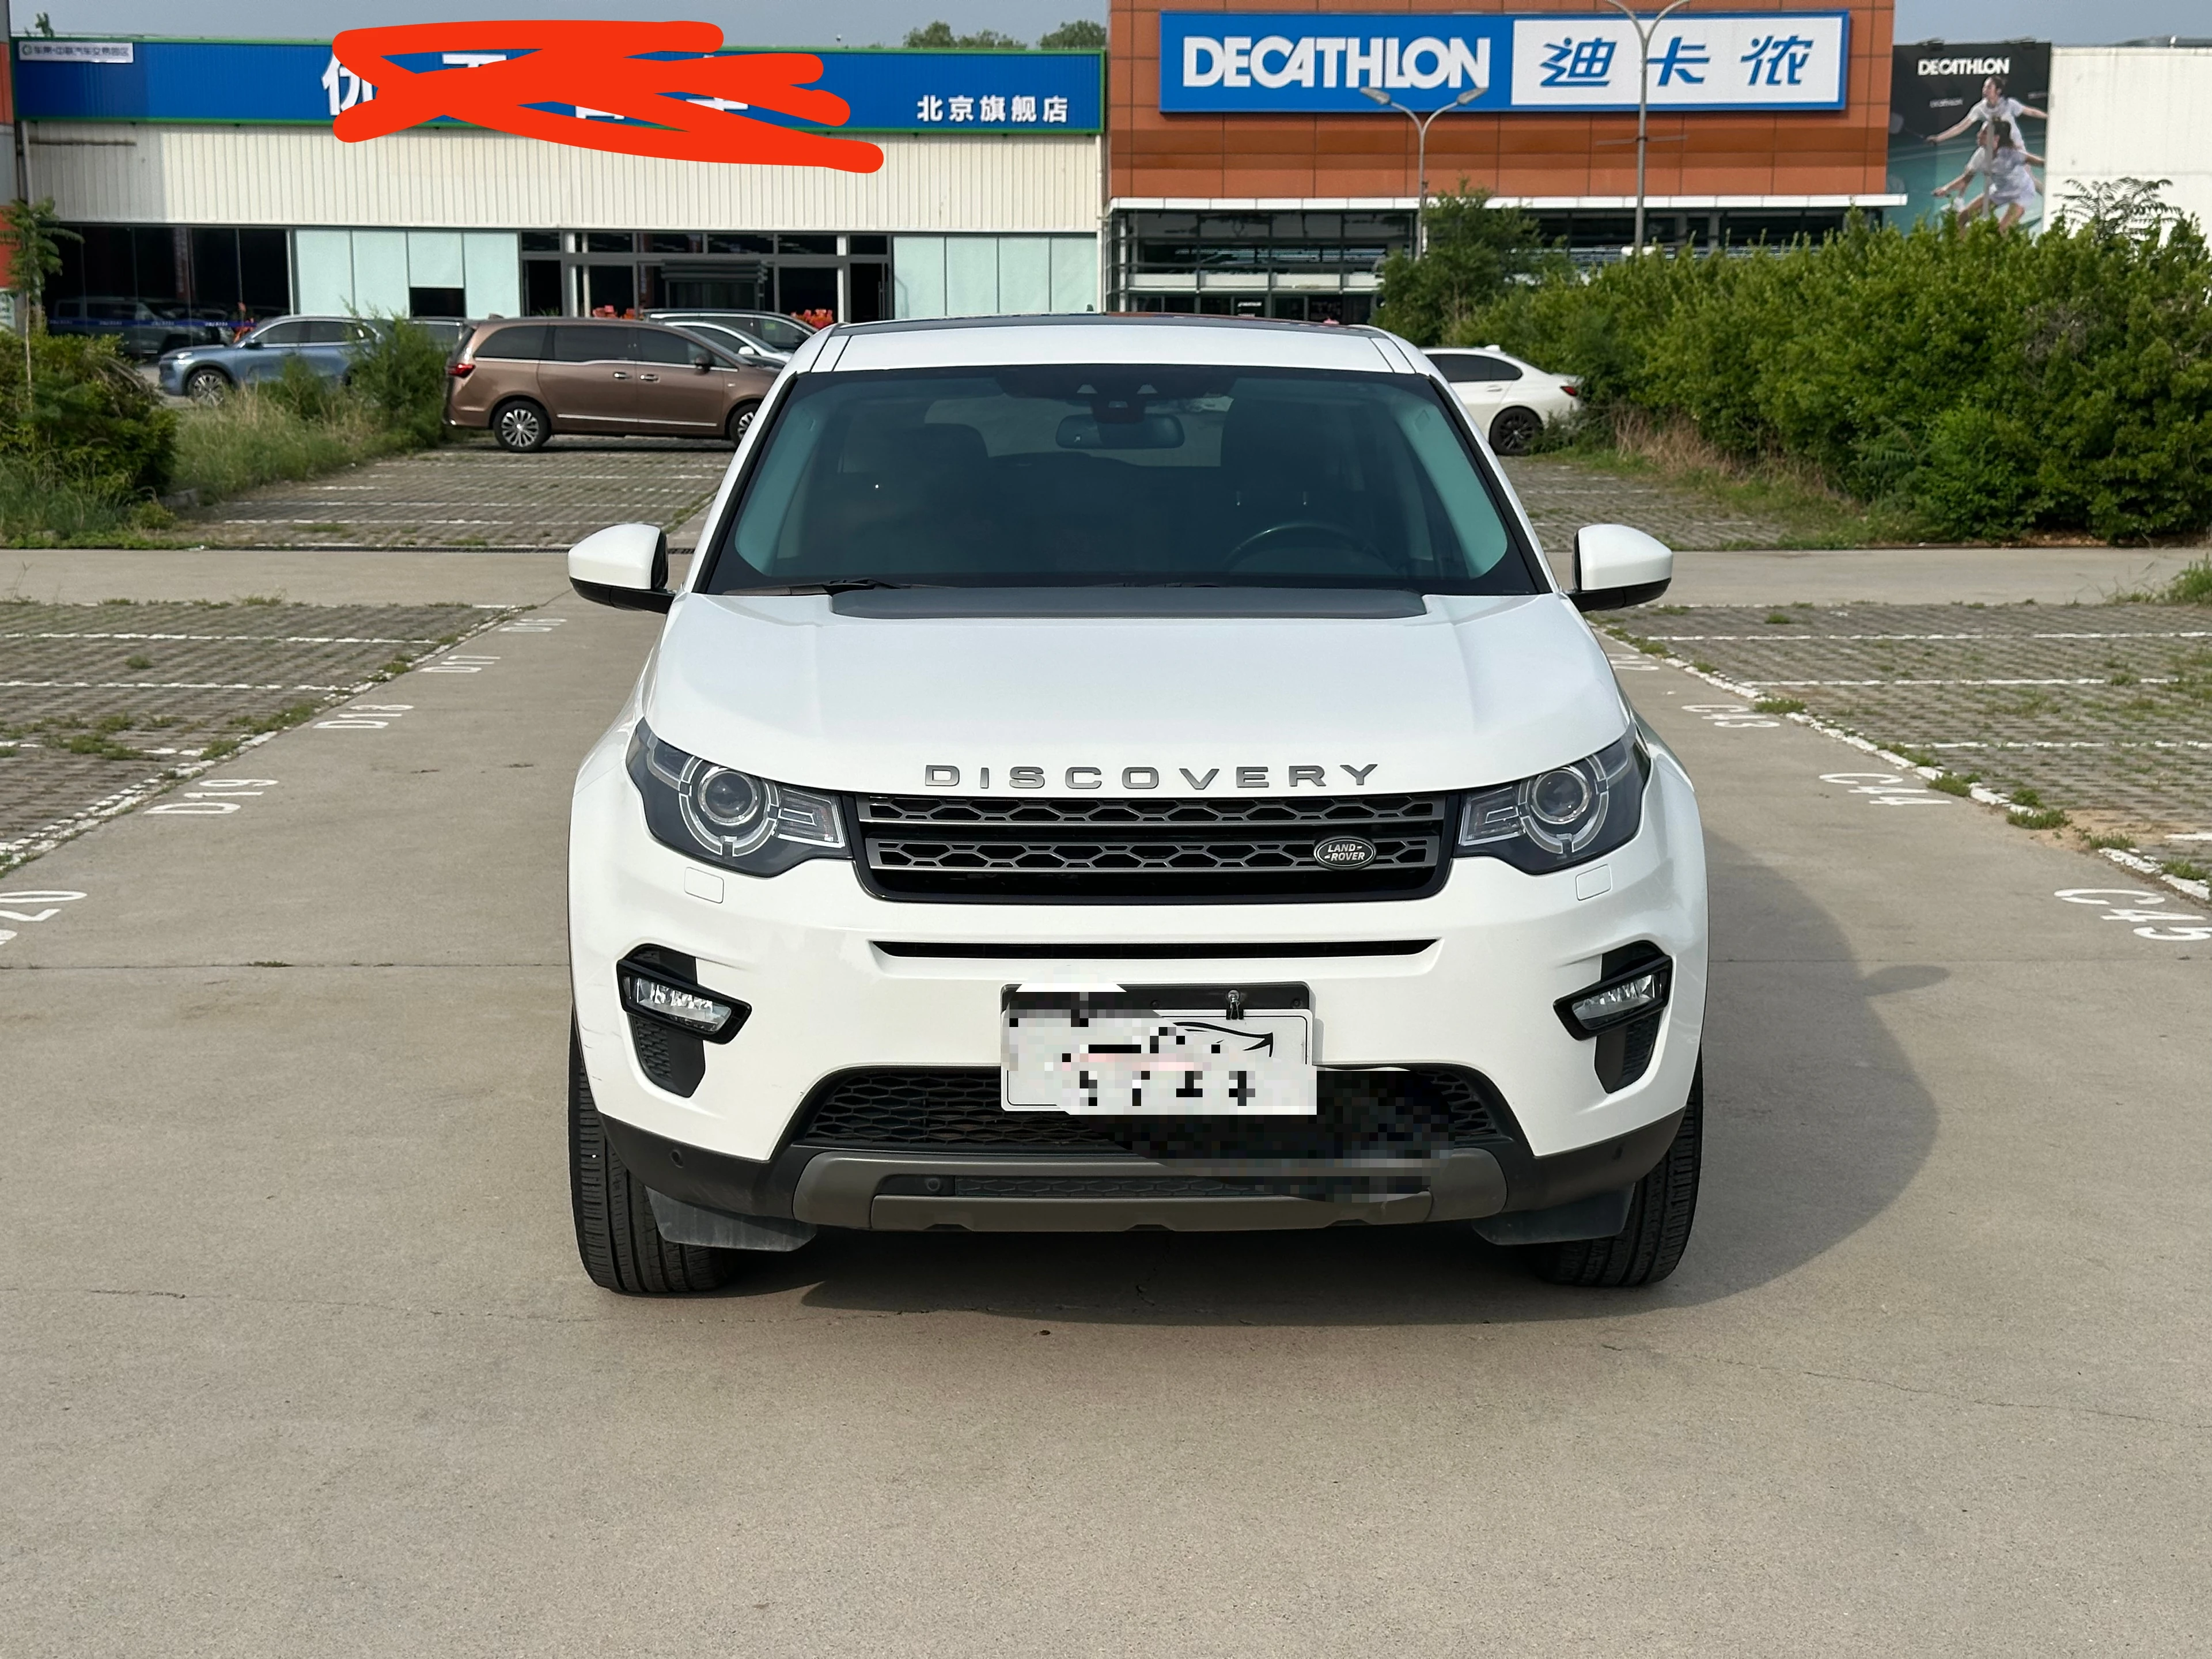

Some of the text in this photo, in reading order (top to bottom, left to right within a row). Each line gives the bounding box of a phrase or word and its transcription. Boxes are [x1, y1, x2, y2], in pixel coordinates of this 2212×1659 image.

[1183, 35, 1491, 89] DECATHLON
[1540, 36, 1814, 87] 迪卡侬
[1918, 57, 2010, 75] DECATHLON
[917, 94, 1067, 123] 北京旗舰店
[312, 704, 414, 729] D18
[1681, 704, 1781, 728] C43
[925, 764, 1378, 790] DISCOVERY
[1819, 772, 1953, 806] C44
[143, 779, 280, 815] D19
